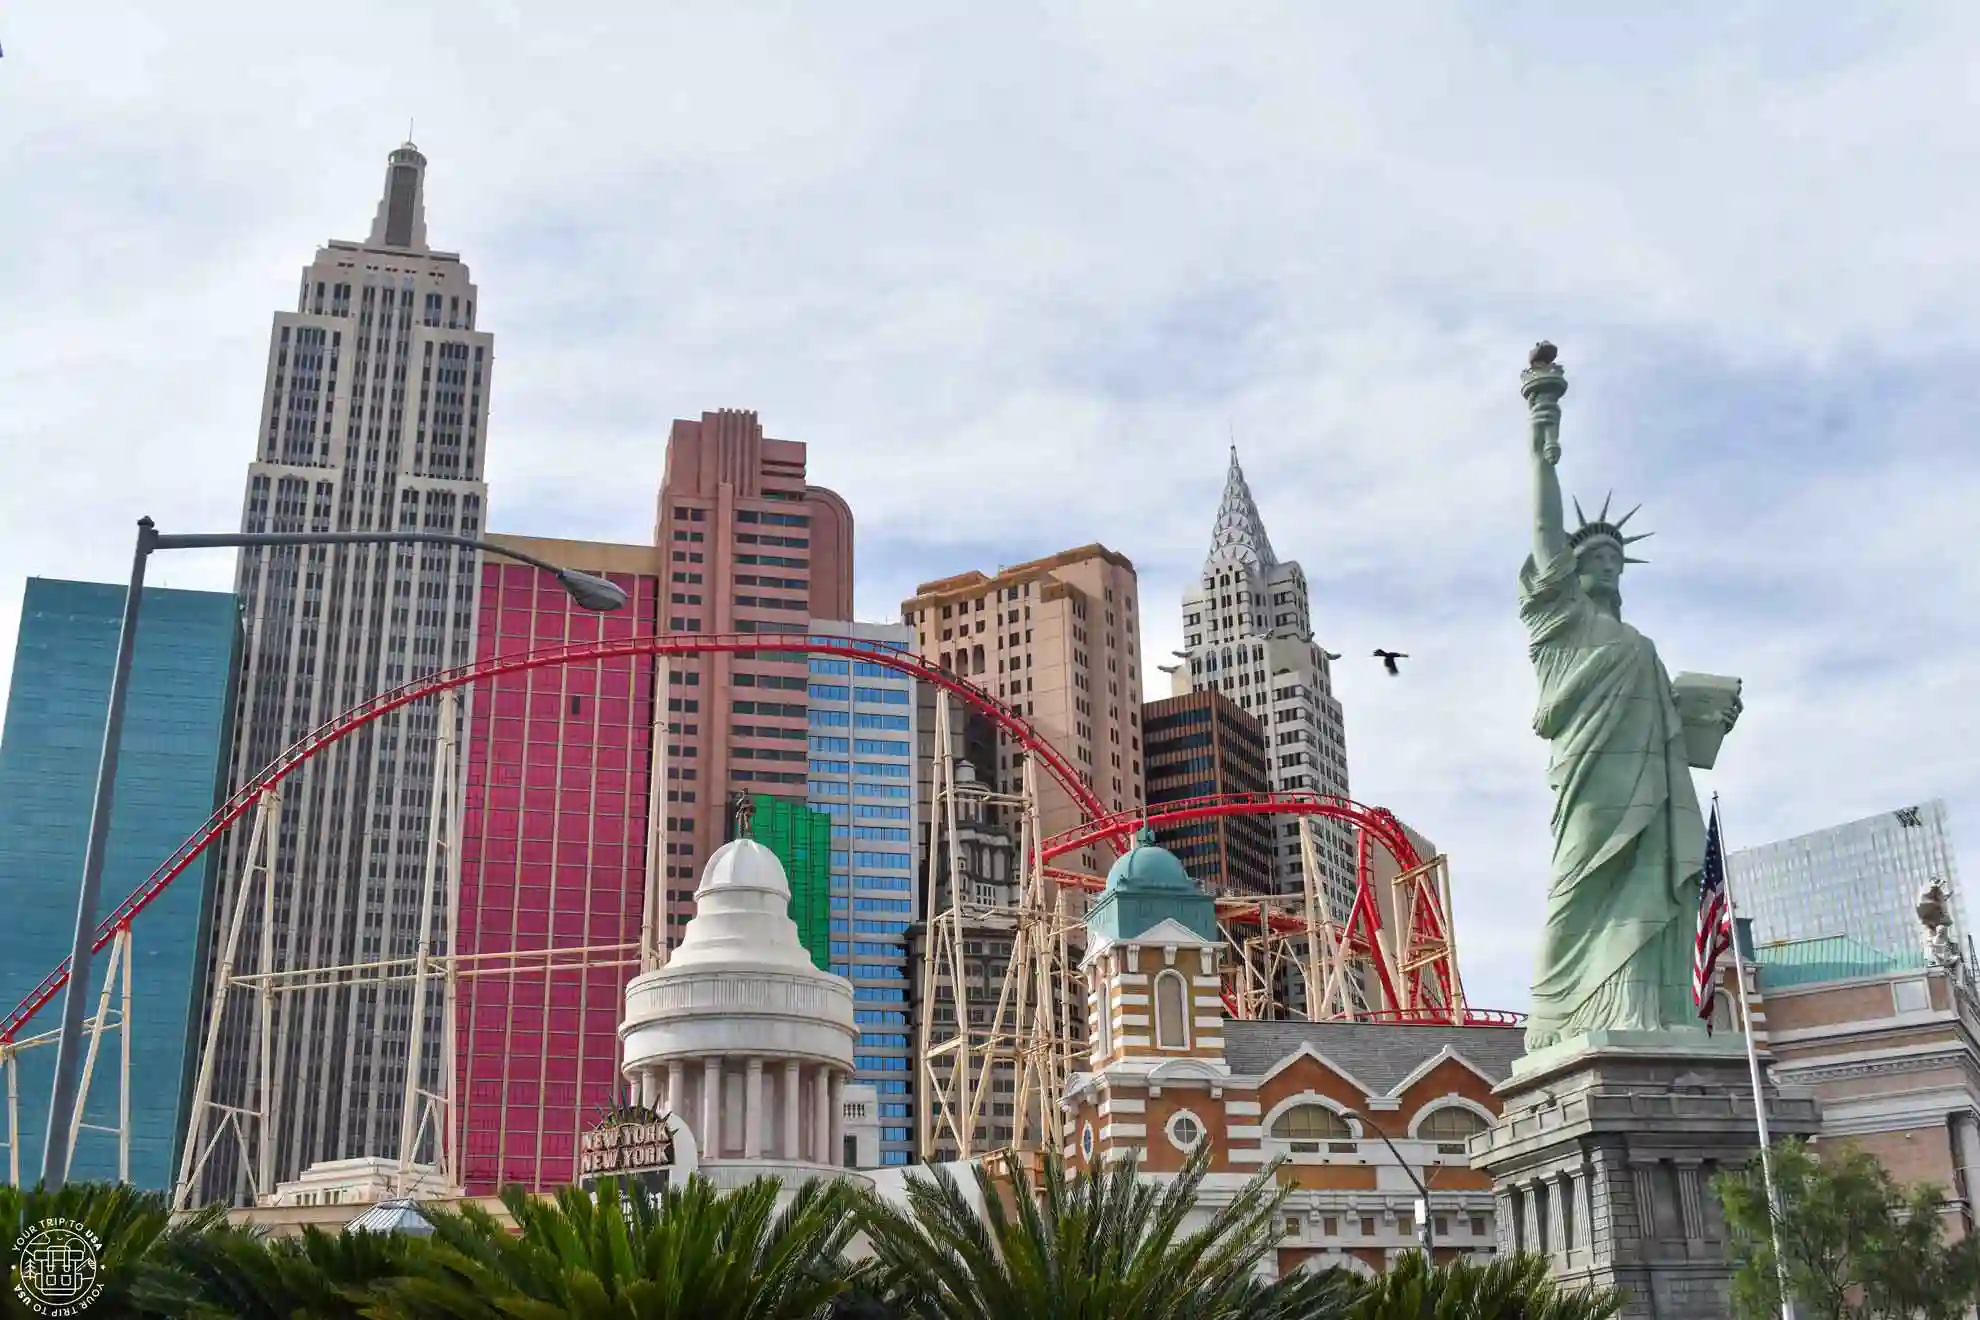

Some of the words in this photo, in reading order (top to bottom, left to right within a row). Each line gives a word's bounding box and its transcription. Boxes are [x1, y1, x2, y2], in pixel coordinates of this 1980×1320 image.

[582, 1128, 619, 1149] NEW
[621, 1122, 669, 1145] YORK
[581, 1150, 618, 1174] NEW
[621, 1143, 670, 1167] YORK
